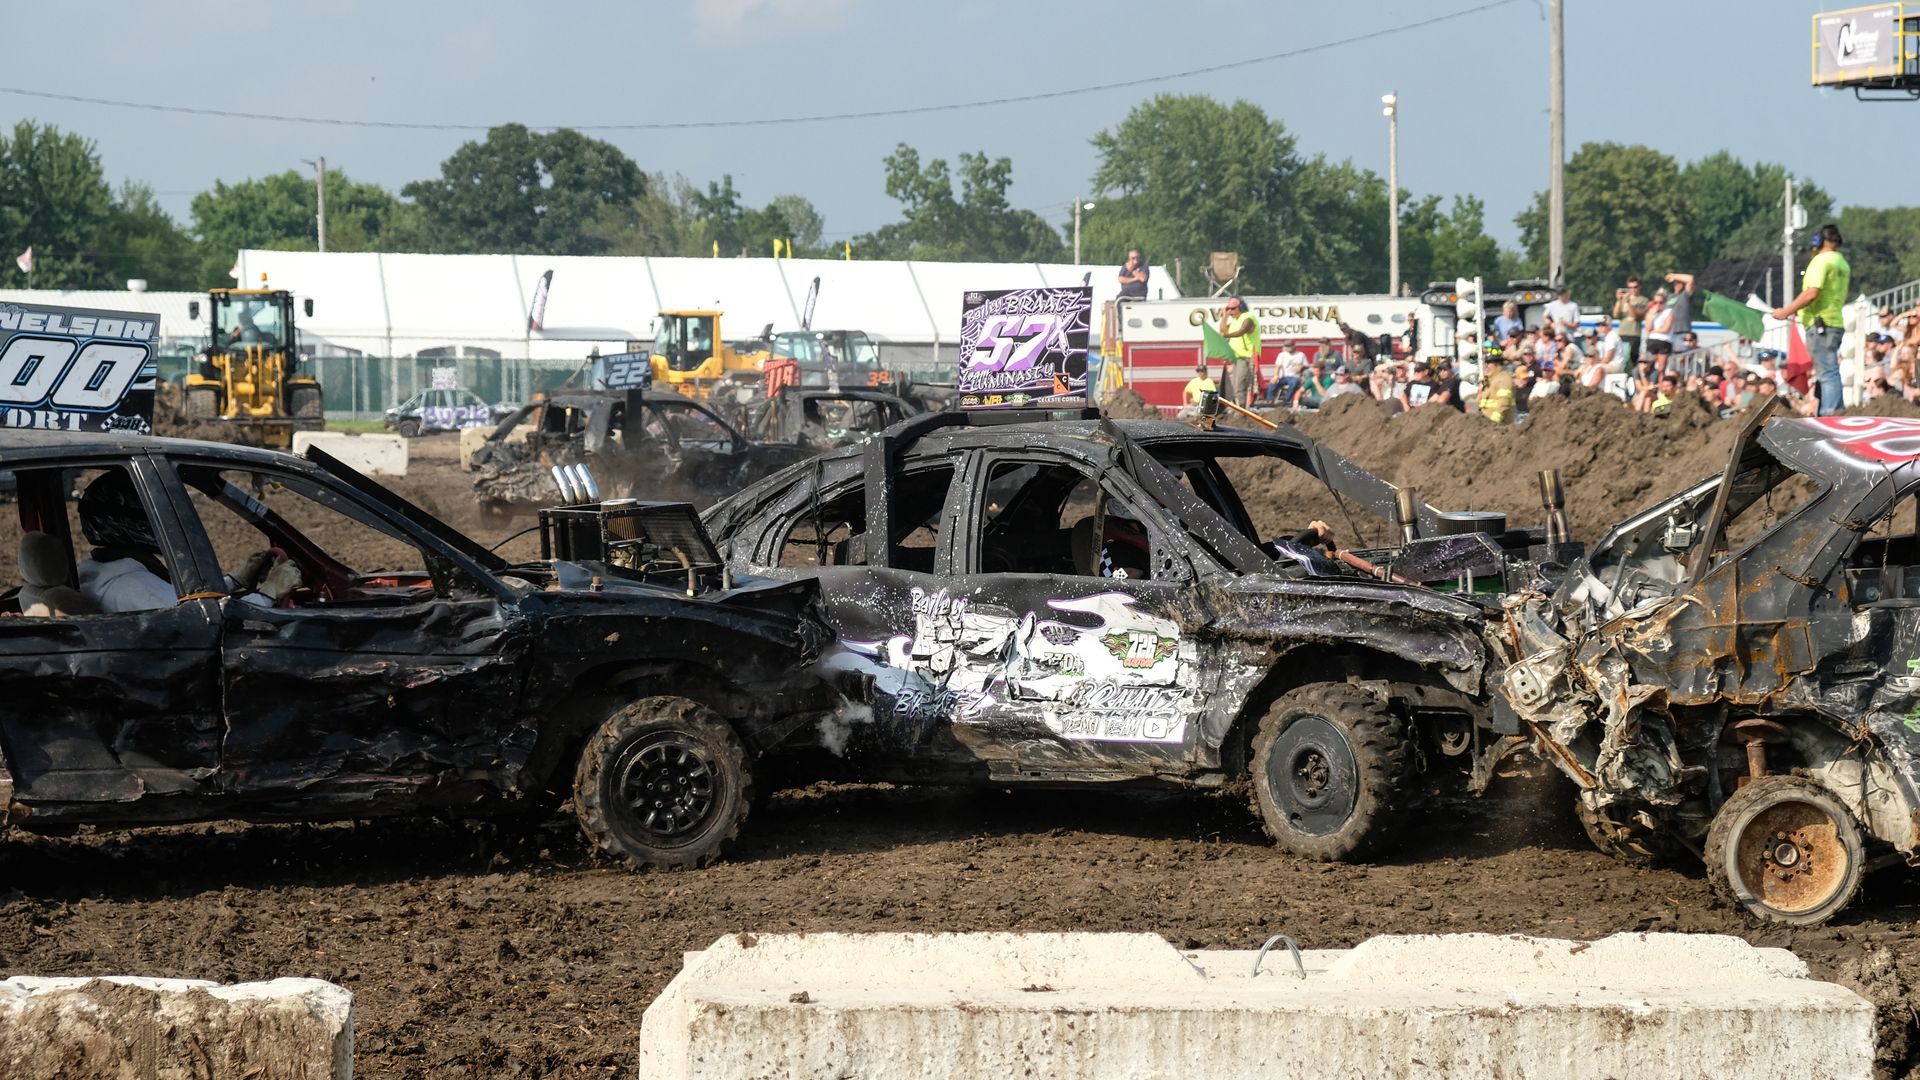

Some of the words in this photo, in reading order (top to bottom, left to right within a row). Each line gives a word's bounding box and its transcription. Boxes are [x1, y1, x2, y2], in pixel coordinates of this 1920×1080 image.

[1005, 290, 1083, 316] BRAATZ
[0, 311, 153, 339] NELSON
[1189, 305, 1342, 327] OWTONNA
[1260, 324, 1308, 334] RESCUE
[607, 361, 648, 385] 22
[910, 586, 968, 621] Bailey
[1062, 716, 1099, 734] DEMO
[1104, 717, 1140, 737] TEAM
